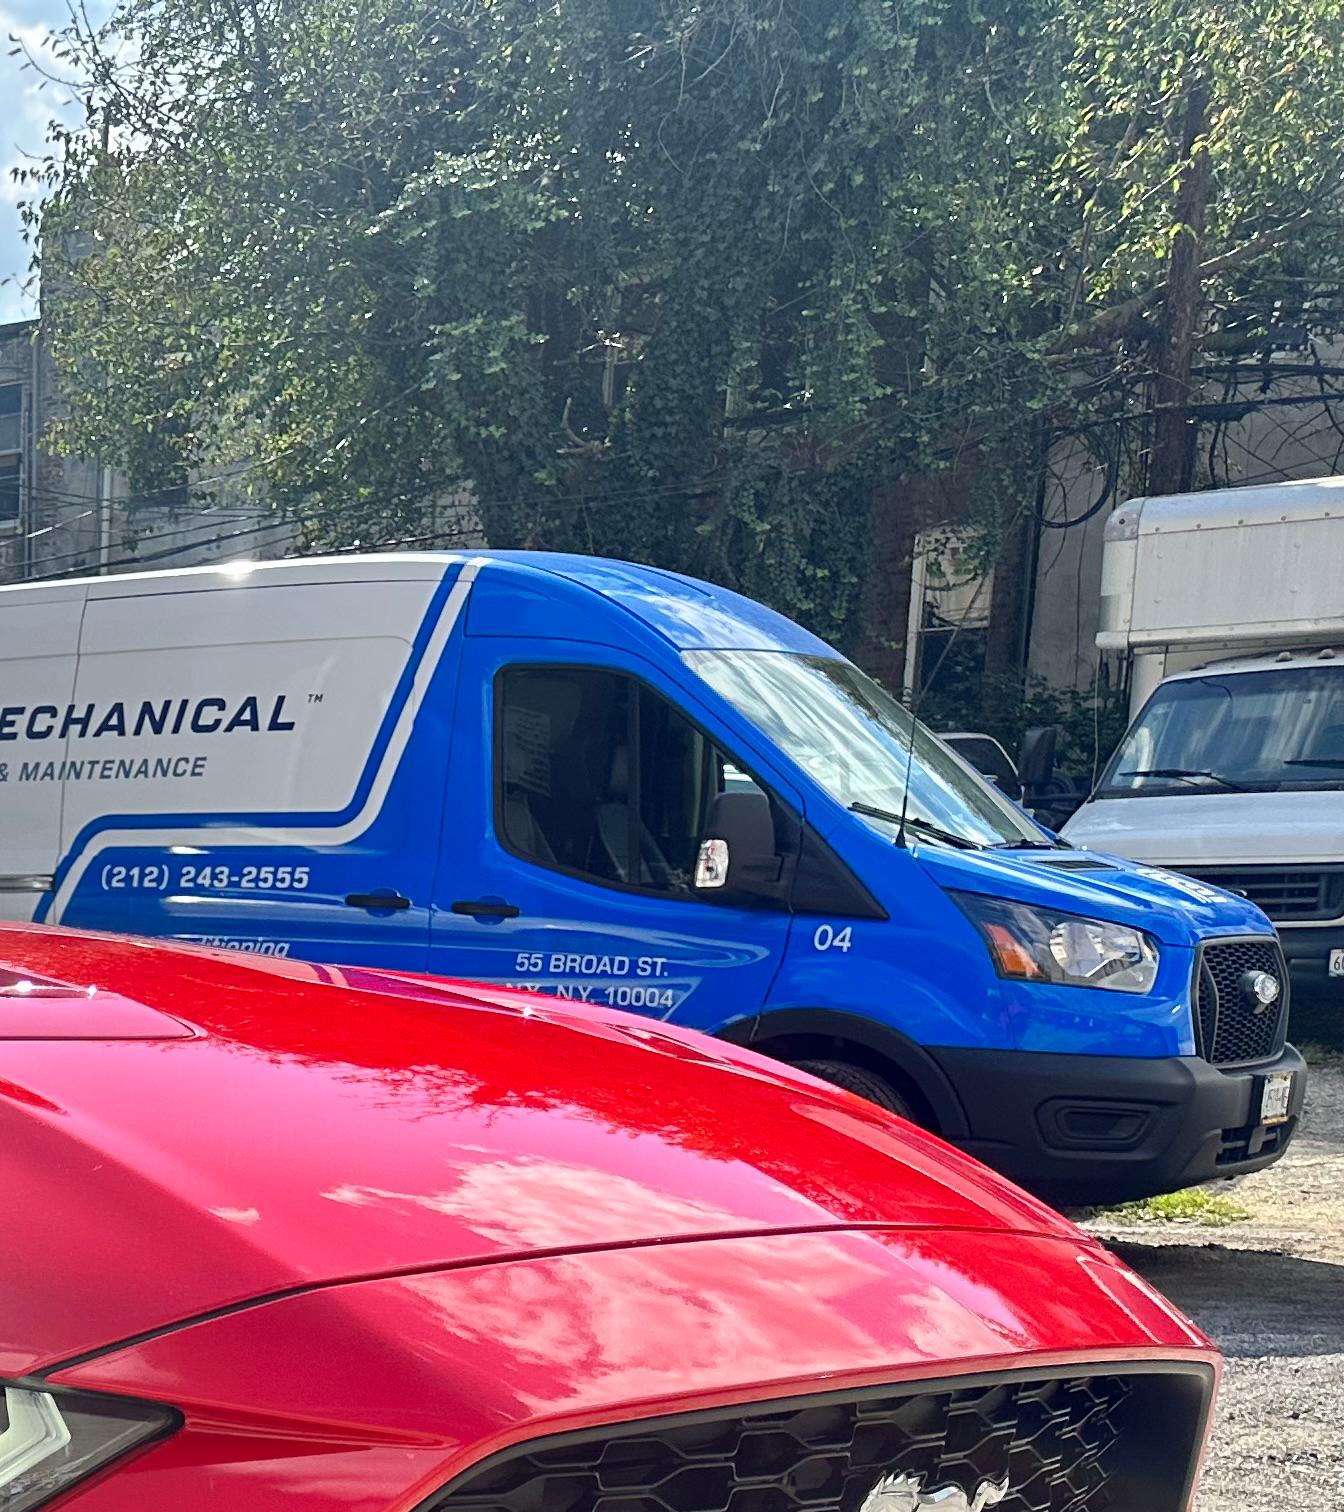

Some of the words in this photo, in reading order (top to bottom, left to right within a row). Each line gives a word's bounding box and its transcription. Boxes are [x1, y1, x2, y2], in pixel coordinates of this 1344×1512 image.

[18, 756, 208, 783] MAINTENANCE
[100, 864, 170, 891] (212)
[179, 866, 311, 889] 243-2555
[813, 924, 852, 953] 04
[515, 953, 544, 972] 55
[550, 954, 630, 976] BROAD
[636, 957, 669, 977] ST.
[556, 984, 595, 1004] NY.
[604, 986, 674, 1008] 10004
